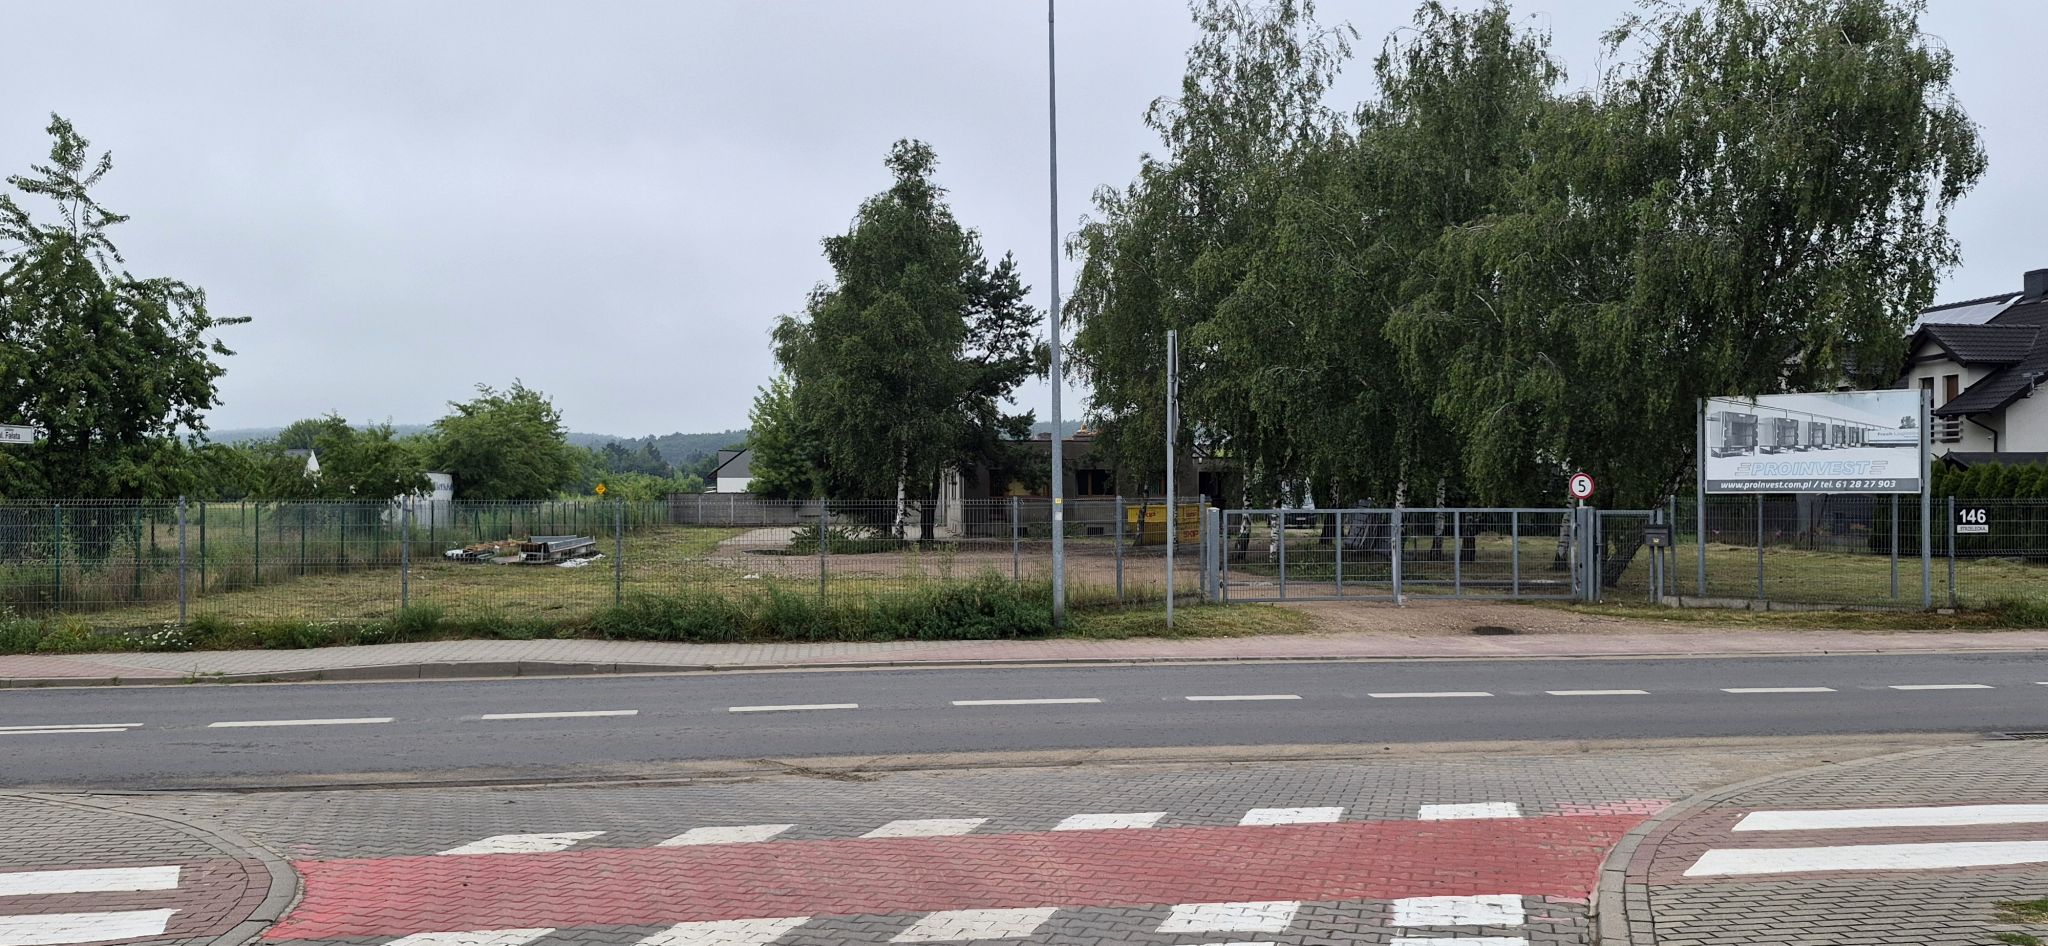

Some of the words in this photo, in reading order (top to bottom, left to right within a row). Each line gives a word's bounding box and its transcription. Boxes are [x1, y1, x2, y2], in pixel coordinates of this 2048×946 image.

[1751, 460, 1870, 476] PROINVEST
[1578, 479, 1586, 493] 5
[1720, 480, 1812, 490] www.proinvest.com.pl
[1820, 480, 1834, 488] tel.
[1835, 480, 1848, 488] 61
[1849, 480, 1862, 488] 28
[1863, 480, 1877, 488] 27
[1878, 480, 1897, 488] 903
[1959, 508, 1987, 523] 146
